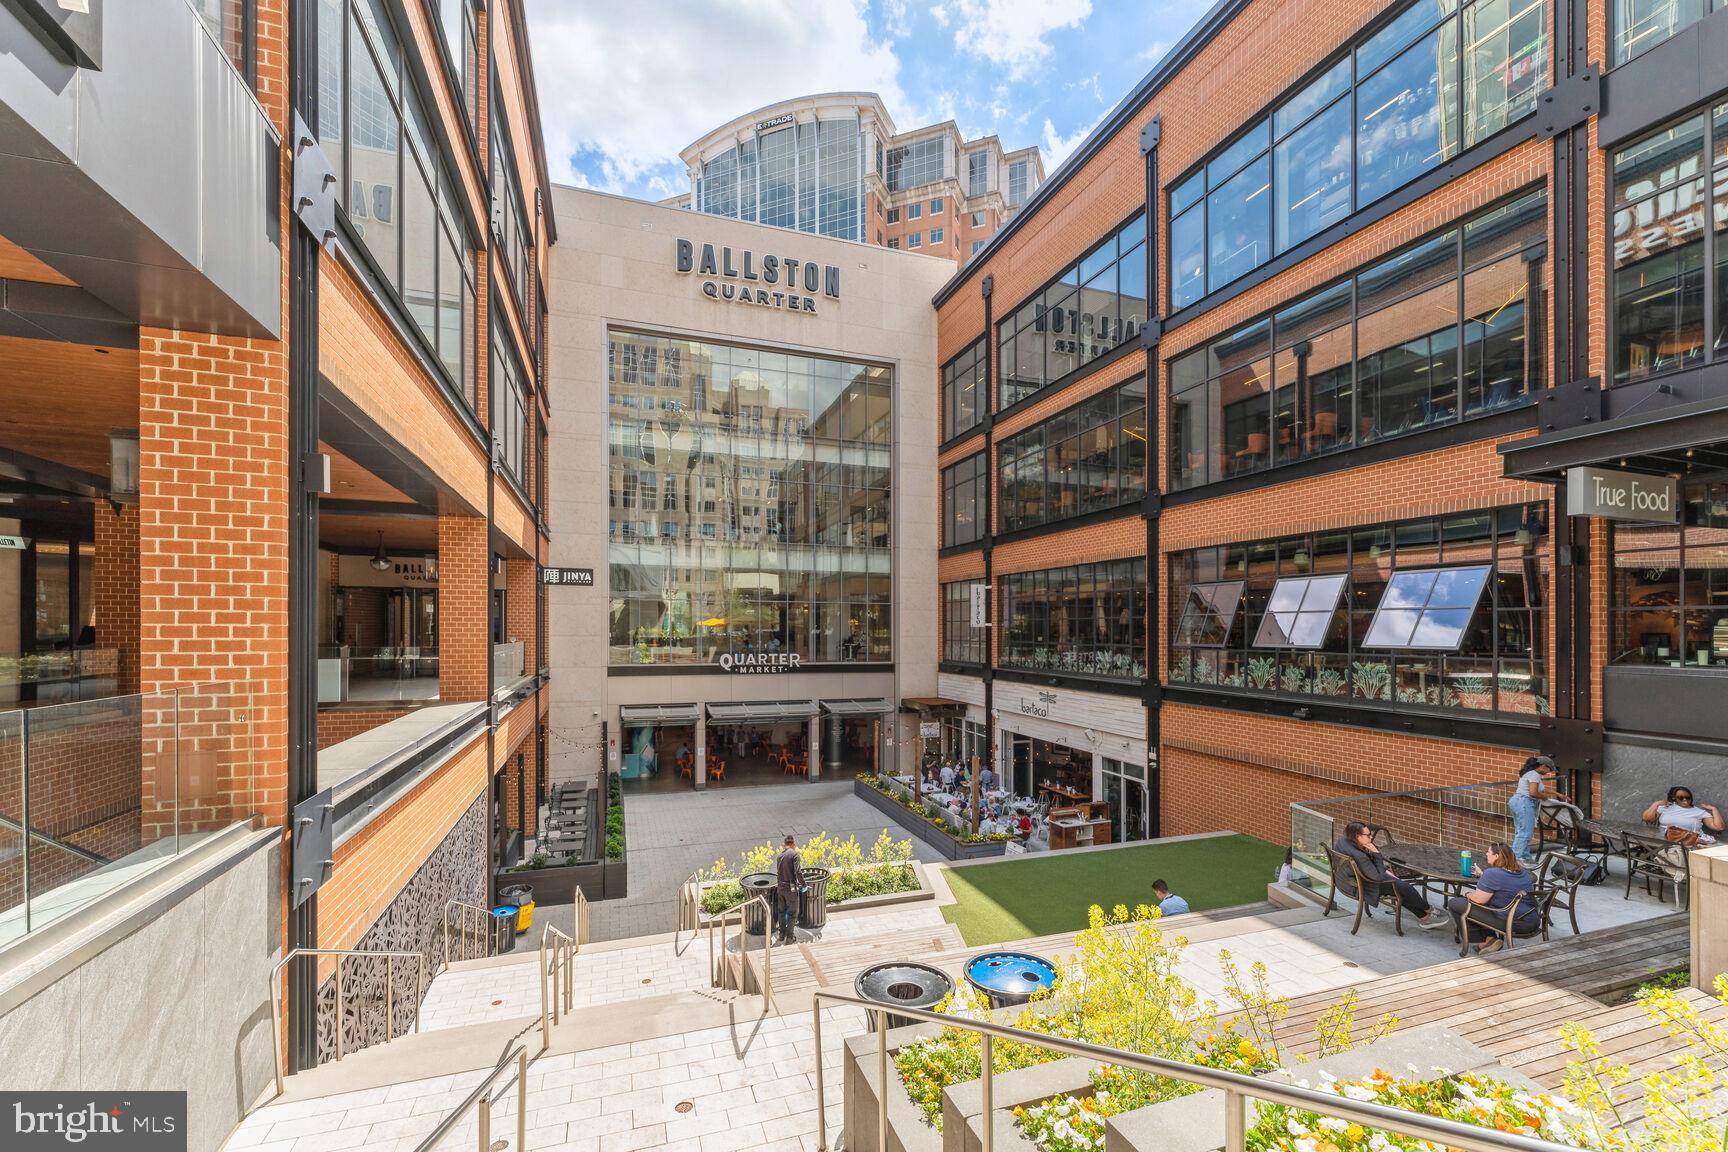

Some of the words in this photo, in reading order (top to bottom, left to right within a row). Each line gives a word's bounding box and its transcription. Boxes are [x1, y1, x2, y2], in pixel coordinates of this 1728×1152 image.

[676, 237, 841, 300] BALLSTON
[702, 280, 818, 314] QUARTER
[1592, 476, 1626, 507] True
[1631, 481, 1669, 511] Food
[563, 571, 591, 583] JINYA
[719, 653, 801, 672] QUARTER
[739, 666, 784, 674] MARKET
[1020, 696, 1047, 718] bartaco
